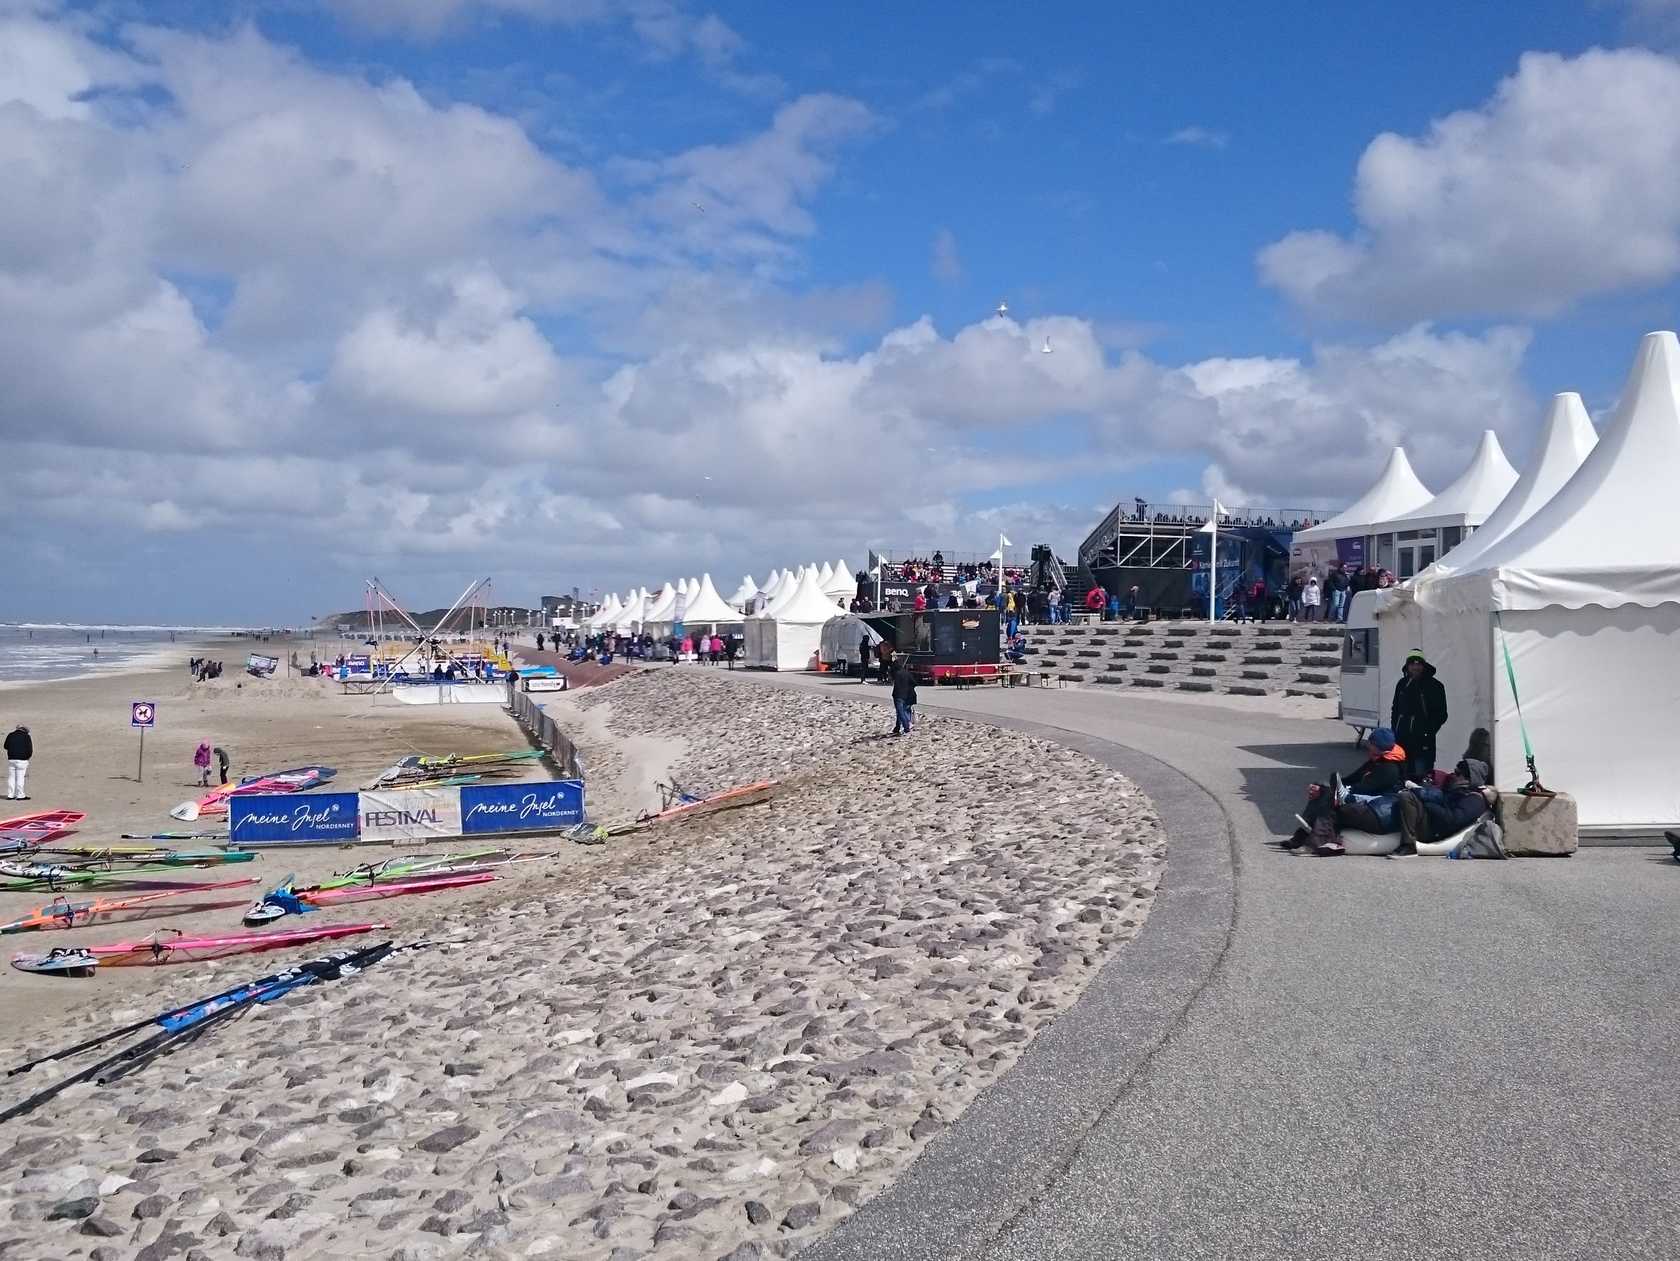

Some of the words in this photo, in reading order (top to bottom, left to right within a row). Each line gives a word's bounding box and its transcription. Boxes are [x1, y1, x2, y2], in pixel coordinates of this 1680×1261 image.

[885, 588, 909, 597] BenQ
[365, 807, 444, 827] FESTIVAL
[464, 802, 518, 821] meine
[234, 813, 289, 831] meine
